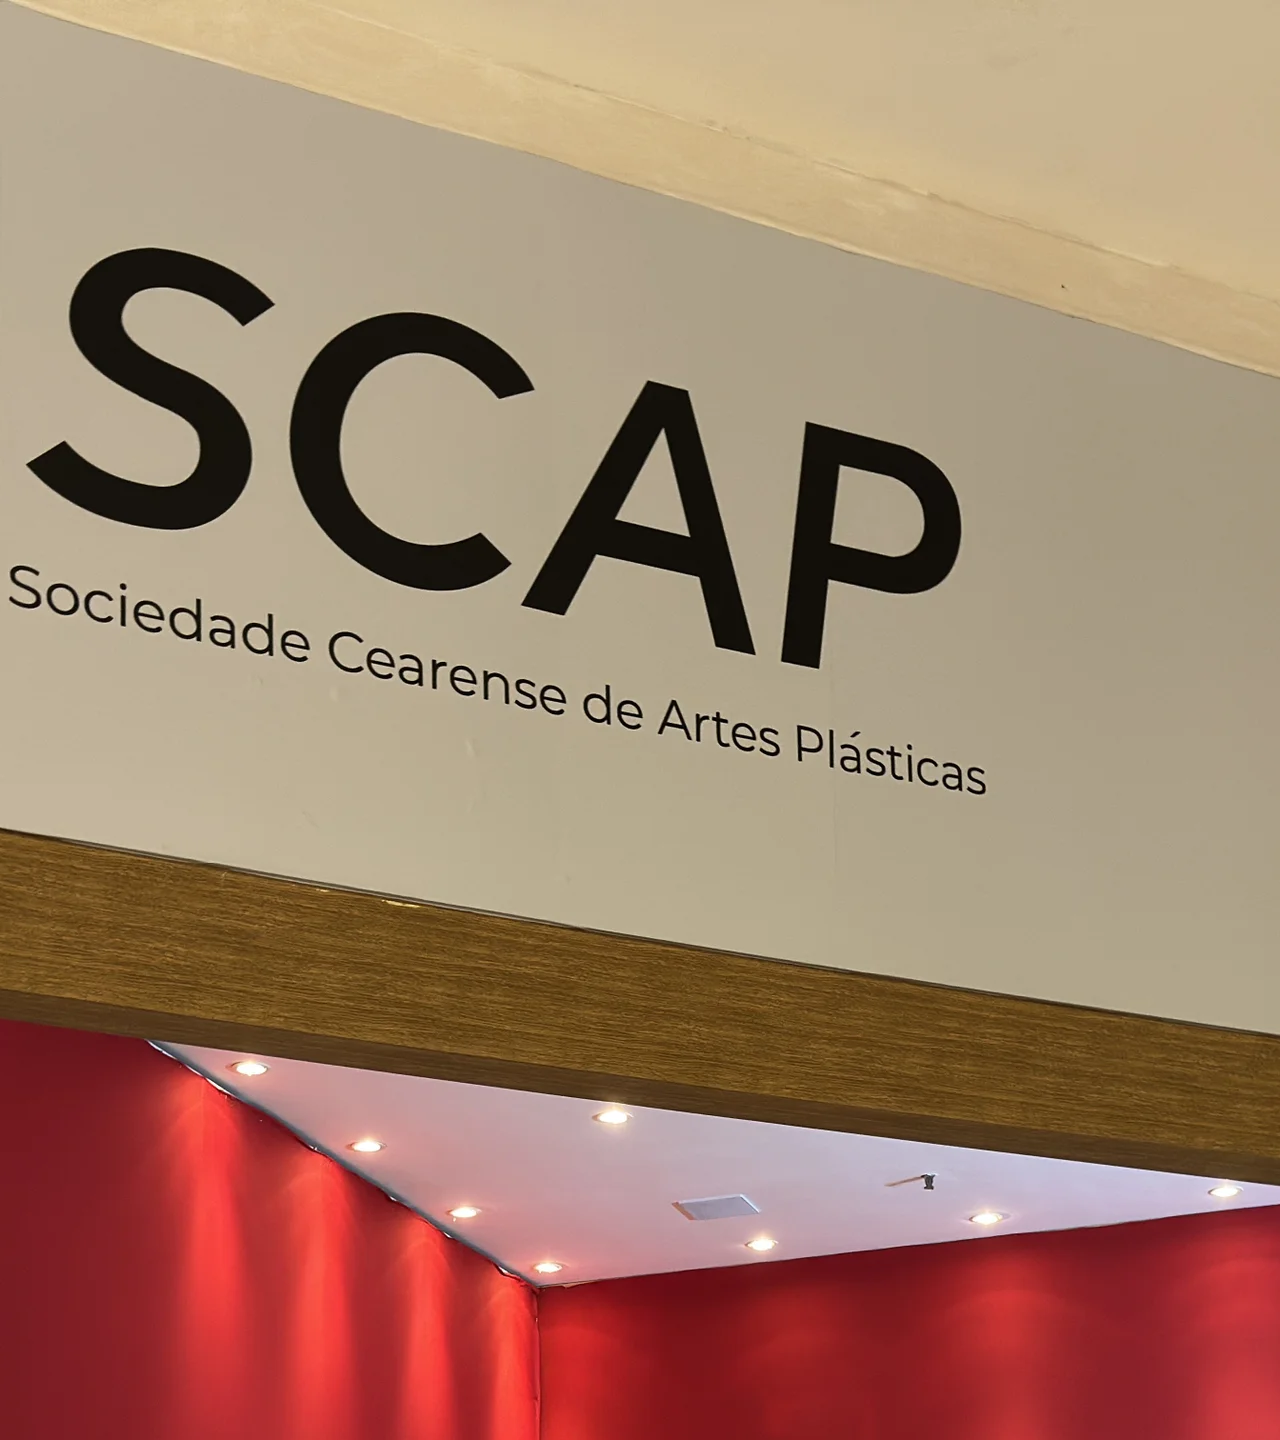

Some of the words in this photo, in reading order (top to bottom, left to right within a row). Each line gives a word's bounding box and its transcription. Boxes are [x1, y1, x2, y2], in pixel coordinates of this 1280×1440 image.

[25, 247, 962, 670] SCAP
[9, 565, 311, 663] Sociedade
[328, 631, 567, 716] Cearense
[583, 684, 644, 730] de
[657, 699, 781, 757] Artes
[795, 724, 987, 796] Plásticas
